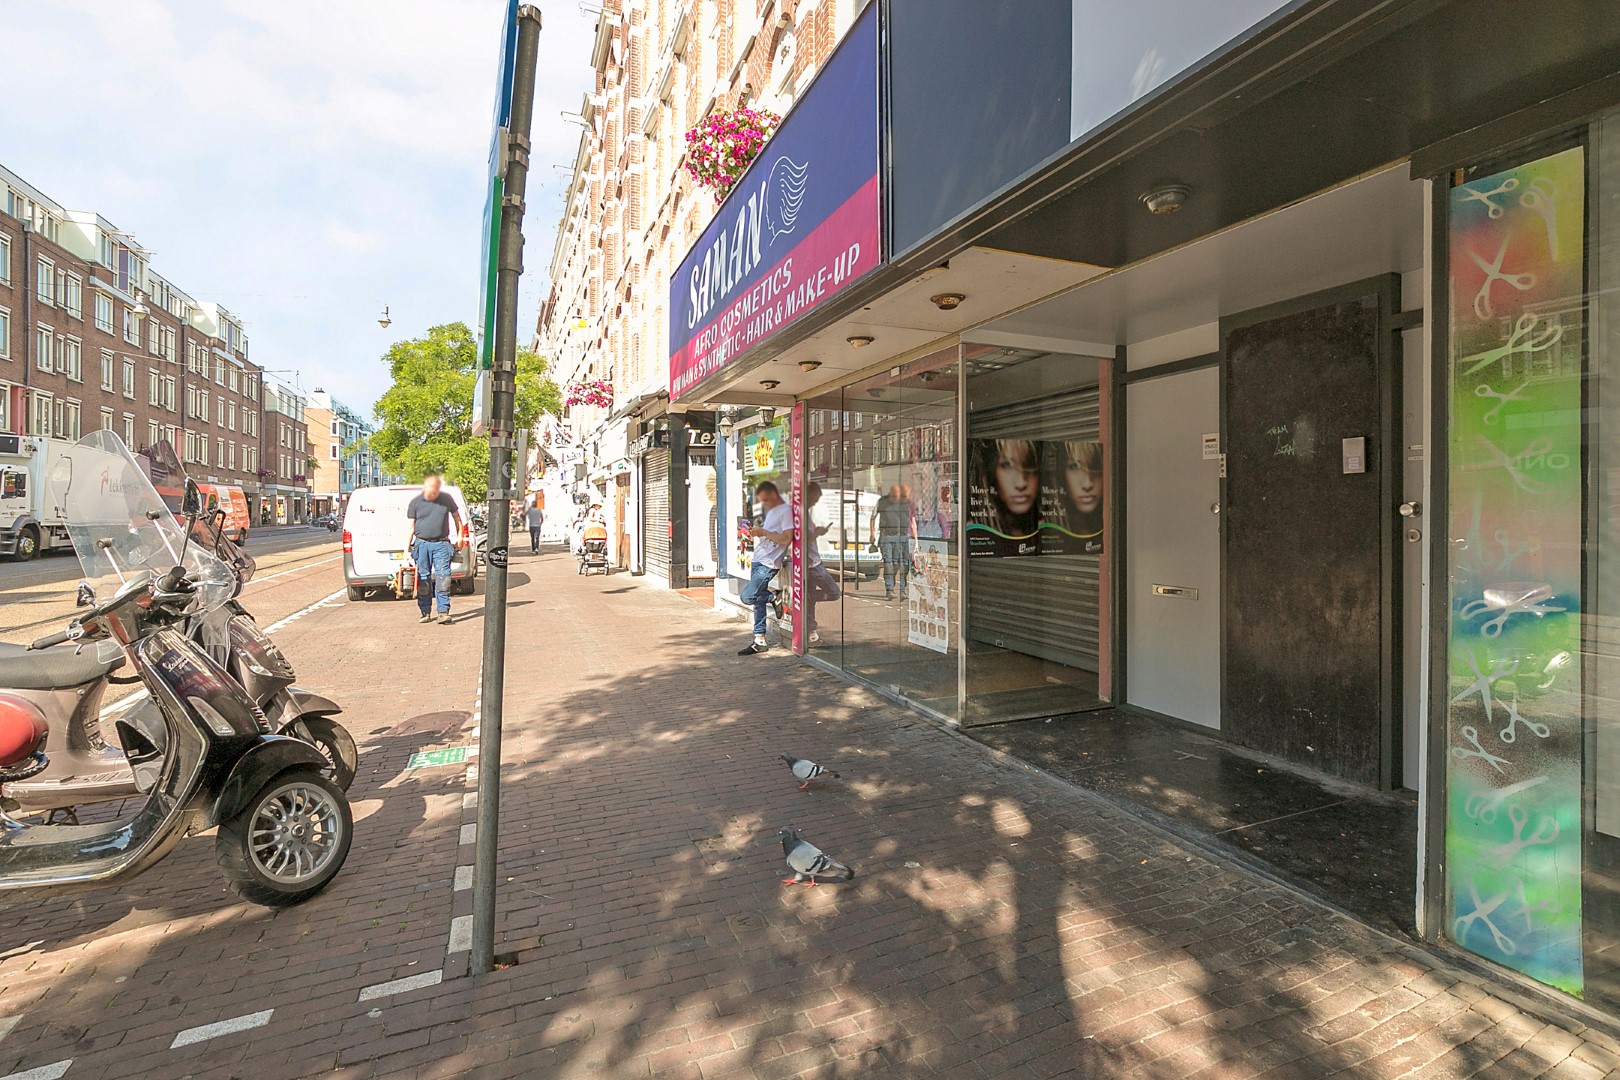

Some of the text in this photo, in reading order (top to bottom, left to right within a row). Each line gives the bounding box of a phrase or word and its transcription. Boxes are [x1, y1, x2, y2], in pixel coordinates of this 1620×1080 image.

[688, 181, 767, 330] SAMAN
[694, 257, 793, 359] AFRO COSMETICS
[698, 331, 741, 377] SYNTHETIC
[746, 307, 774, 344] HAIR
[774, 303, 783, 326] &
[784, 242, 860, 320] MAKE-UP
[970, 485, 989, 494] Move
[970, 496, 983, 506] live
[970, 508, 988, 517] work
[1041, 508, 1058, 517] work
[793, 437, 801, 611] HAIR & COSMETICS
